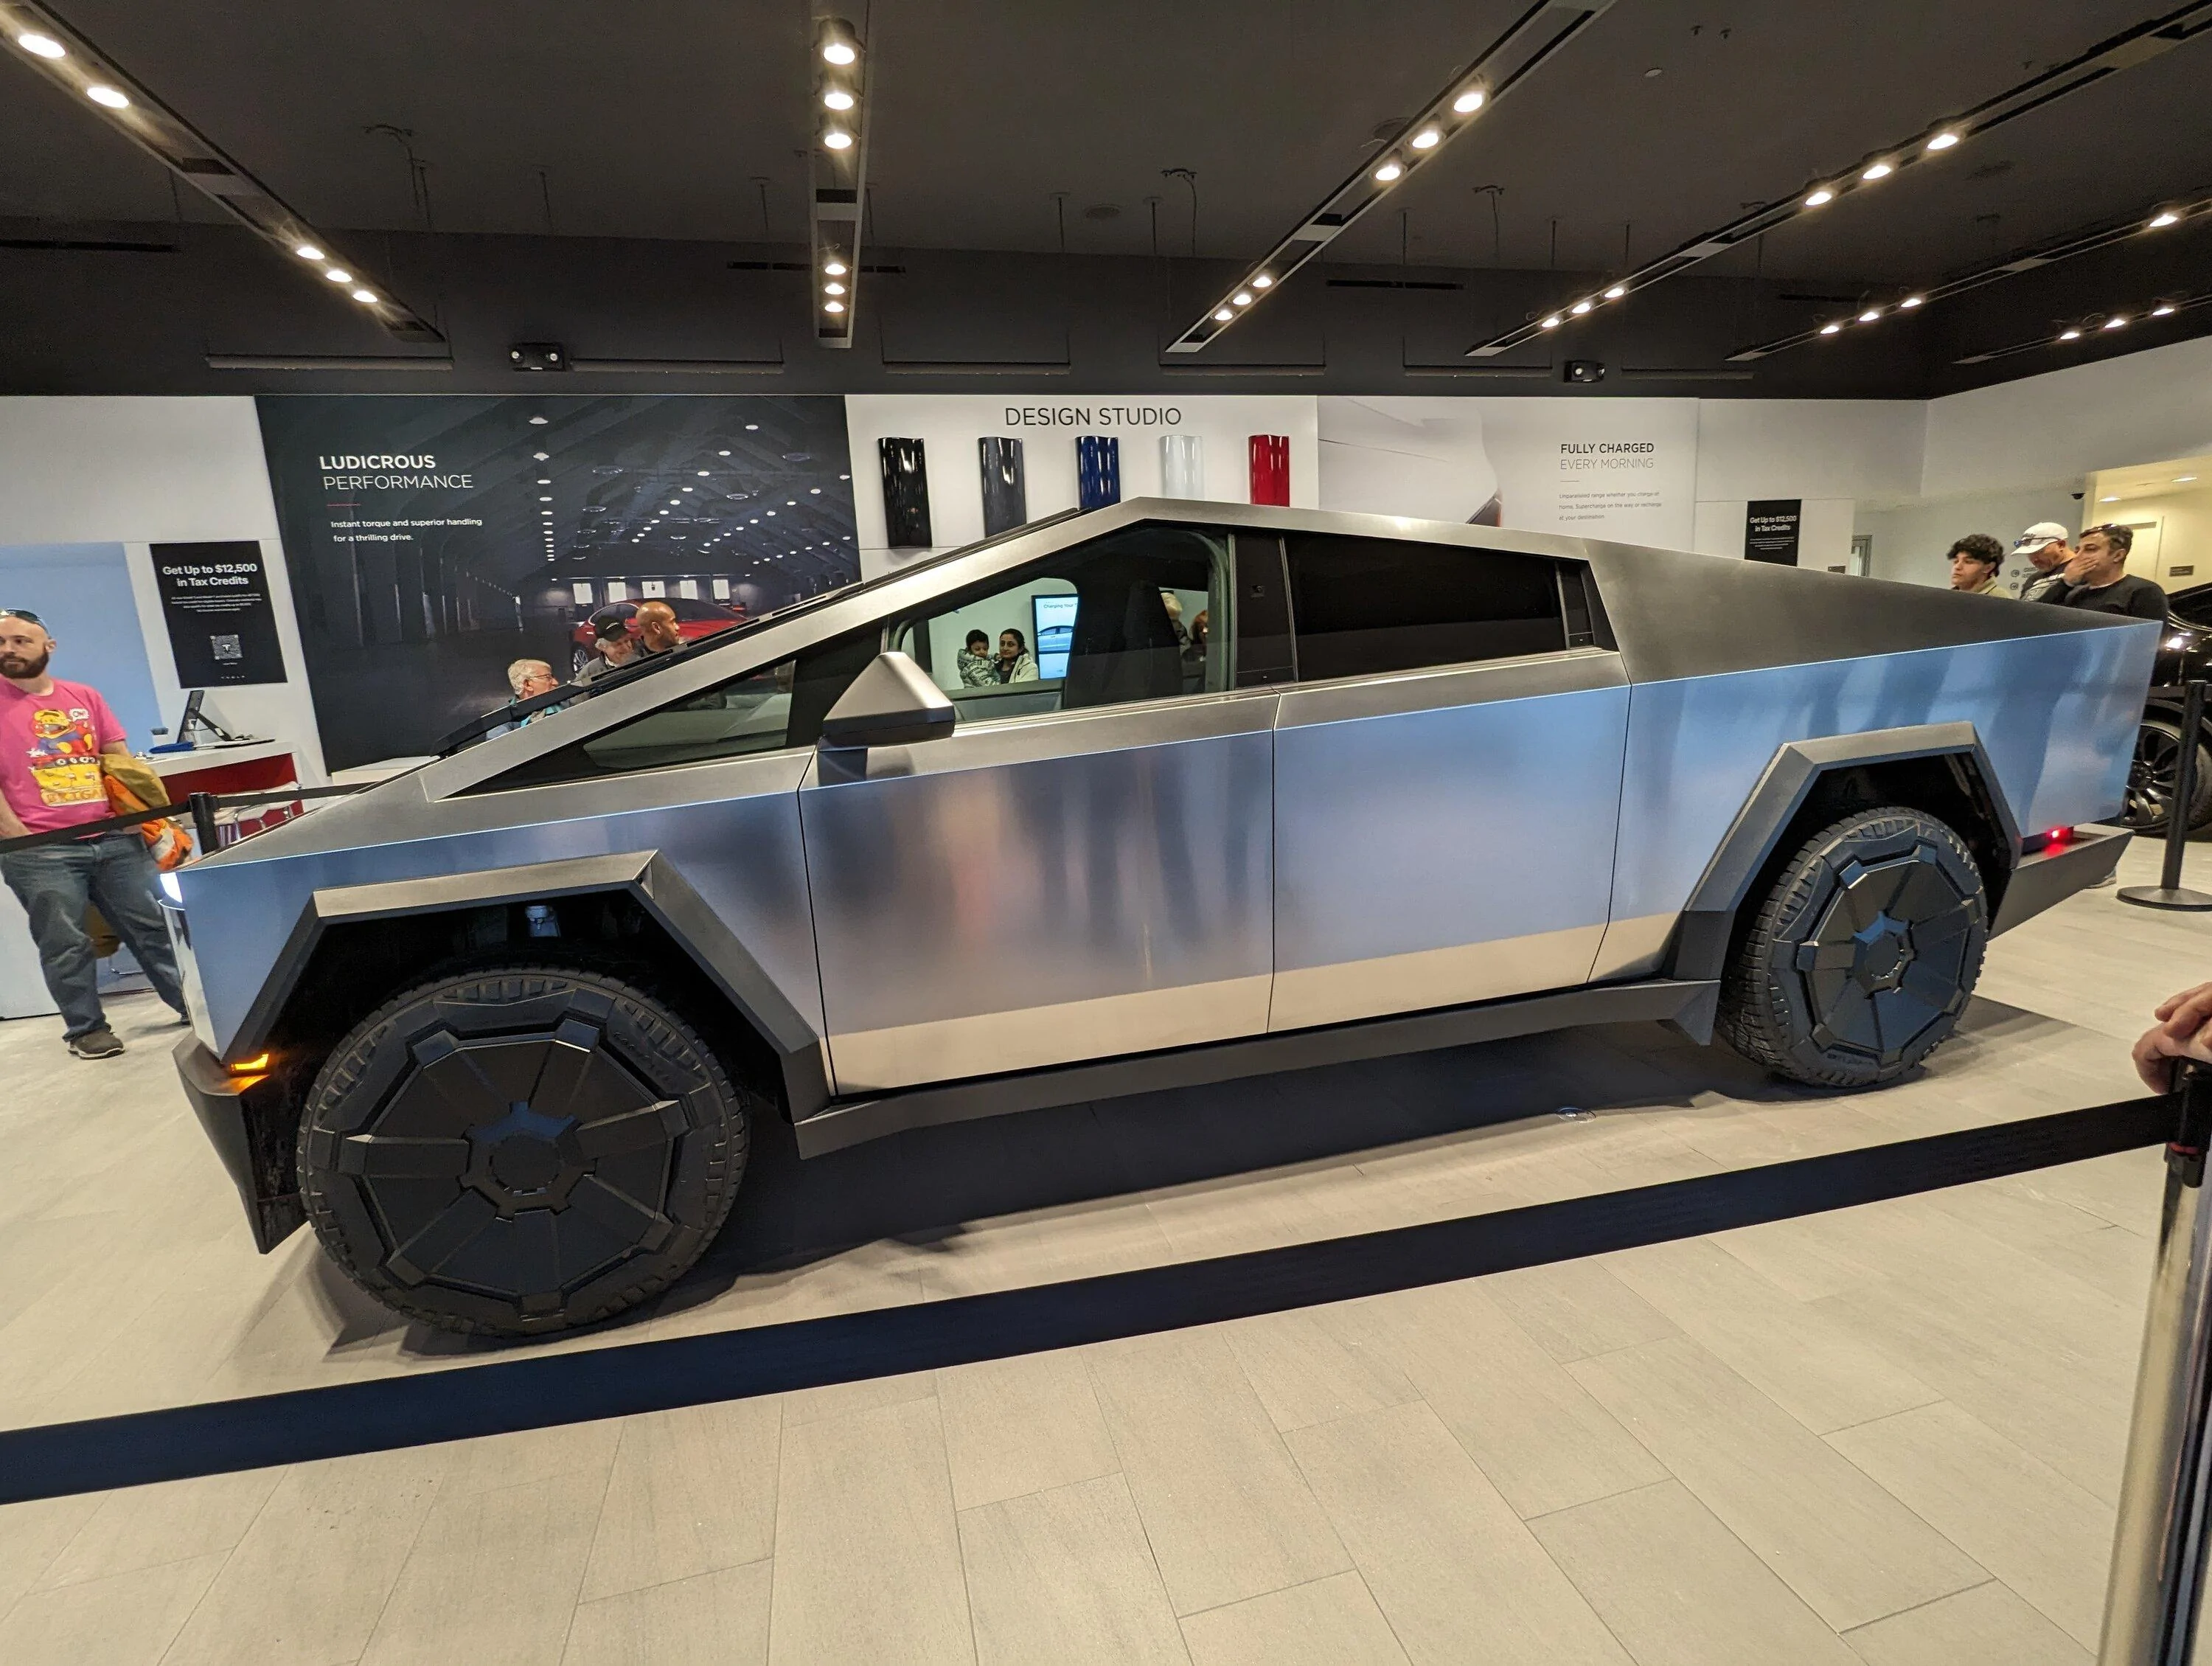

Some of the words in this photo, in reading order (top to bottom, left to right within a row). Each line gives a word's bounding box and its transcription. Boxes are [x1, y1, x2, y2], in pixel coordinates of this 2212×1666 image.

[1005, 408, 1091, 426] DESIGN
[1099, 408, 1182, 426] STUDIO
[1561, 444, 1596, 454] FULLY
[1599, 443, 1654, 453] CHARGED
[319, 455, 437, 470] LUDICROUS
[1560, 459, 1598, 469] EVERY
[1601, 458, 1654, 468] MORNING
[323, 475, 474, 490] PERFORMANCE
[447, 518, 483, 527] handling
[355, 534, 389, 542] thrilling
[163, 566, 184, 575] Get
[184, 565, 201, 576] Up
[201, 566, 214, 574] to
[215, 563, 257, 574] $12,500
[176, 577, 187, 586] in
[188, 577, 208, 586] Tax
[209, 576, 249, 586] Credits
